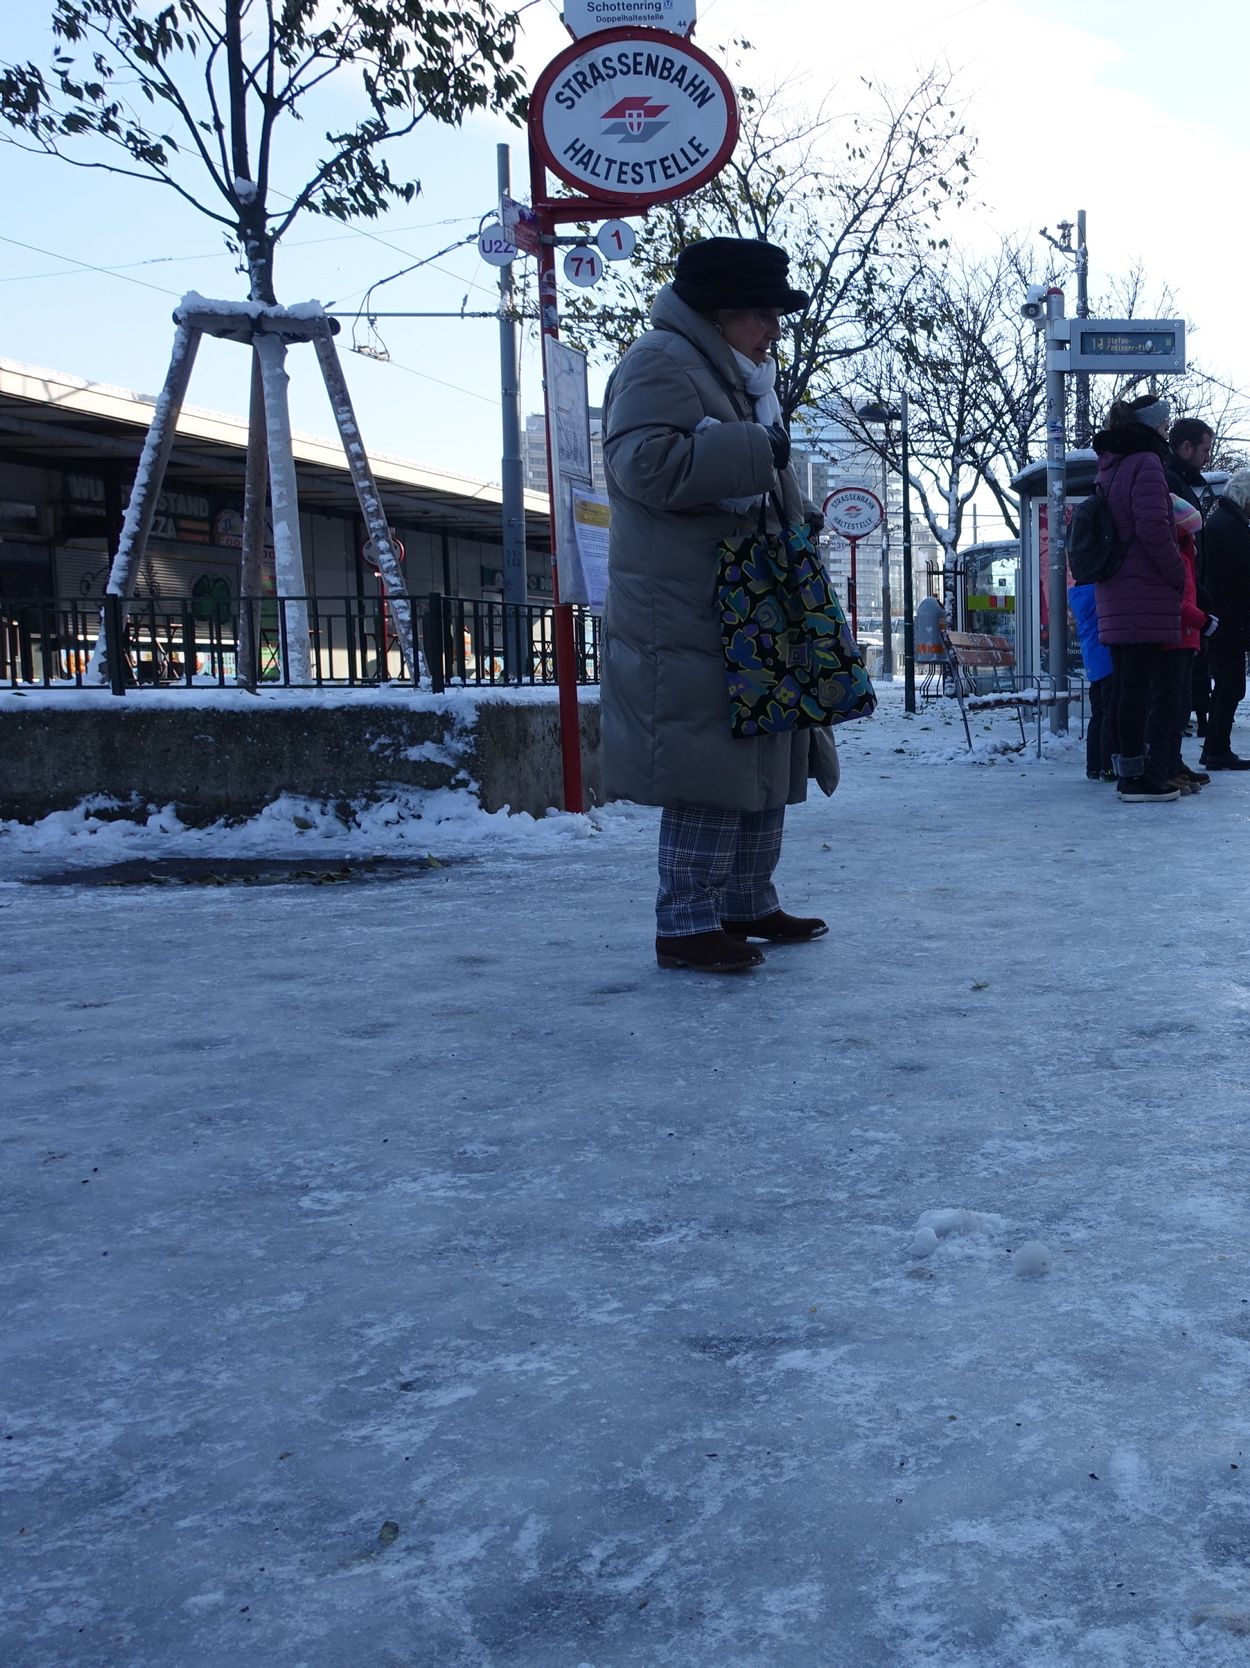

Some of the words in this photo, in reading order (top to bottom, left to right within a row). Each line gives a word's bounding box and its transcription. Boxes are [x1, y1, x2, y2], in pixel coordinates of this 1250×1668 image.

[587, 0, 662, 12] Schottenring
[596, 13, 664, 24] Doppelhaltestelle
[677, 20, 687, 28] 44
[554, 52, 716, 111] STRASSENBAHN
[563, 136, 710, 186] HALTESTELLE
[610, 229, 624, 250] 1
[570, 257, 596, 277] 71
[831, 493, 877, 511] STRASSENBAHN
[832, 516, 874, 530] HALTESTELLE
